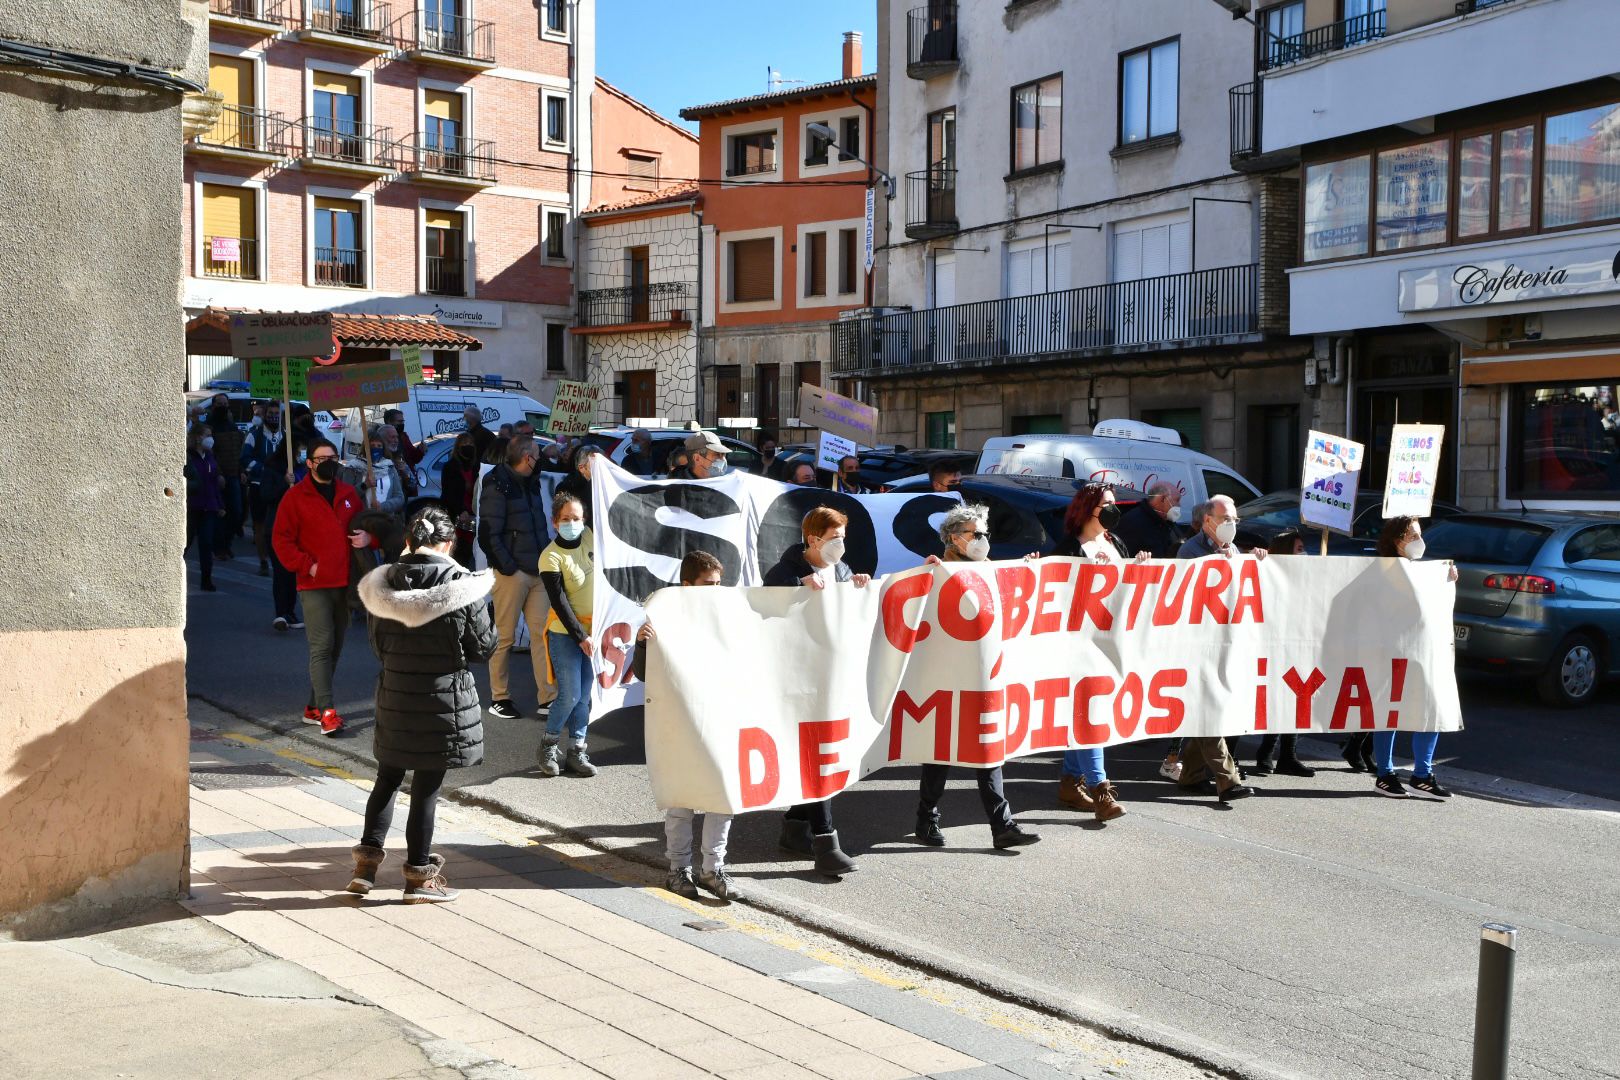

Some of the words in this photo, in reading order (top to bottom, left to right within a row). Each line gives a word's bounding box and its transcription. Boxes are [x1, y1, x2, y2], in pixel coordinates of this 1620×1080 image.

[1394, 160, 1434, 172] EMPRESAS
[865, 191, 873, 265] PESCADERIA
[1453, 263, 1568, 304] Cafeteria
[262, 314, 329, 328] OBLIGACIONES
[444, 310, 483, 320] cajacírculo
[1314, 438, 1356, 460] MENOS
[1400, 436, 1434, 449] MENOS
[1314, 475, 1343, 496] MÁS
[1399, 466, 1422, 484] MÁS
[1304, 491, 1352, 512] SOLUCIONES
[881, 558, 1265, 654] COBERTURA
[888, 650, 1187, 765] MÉDICOS
[738, 717, 850, 809] DE
